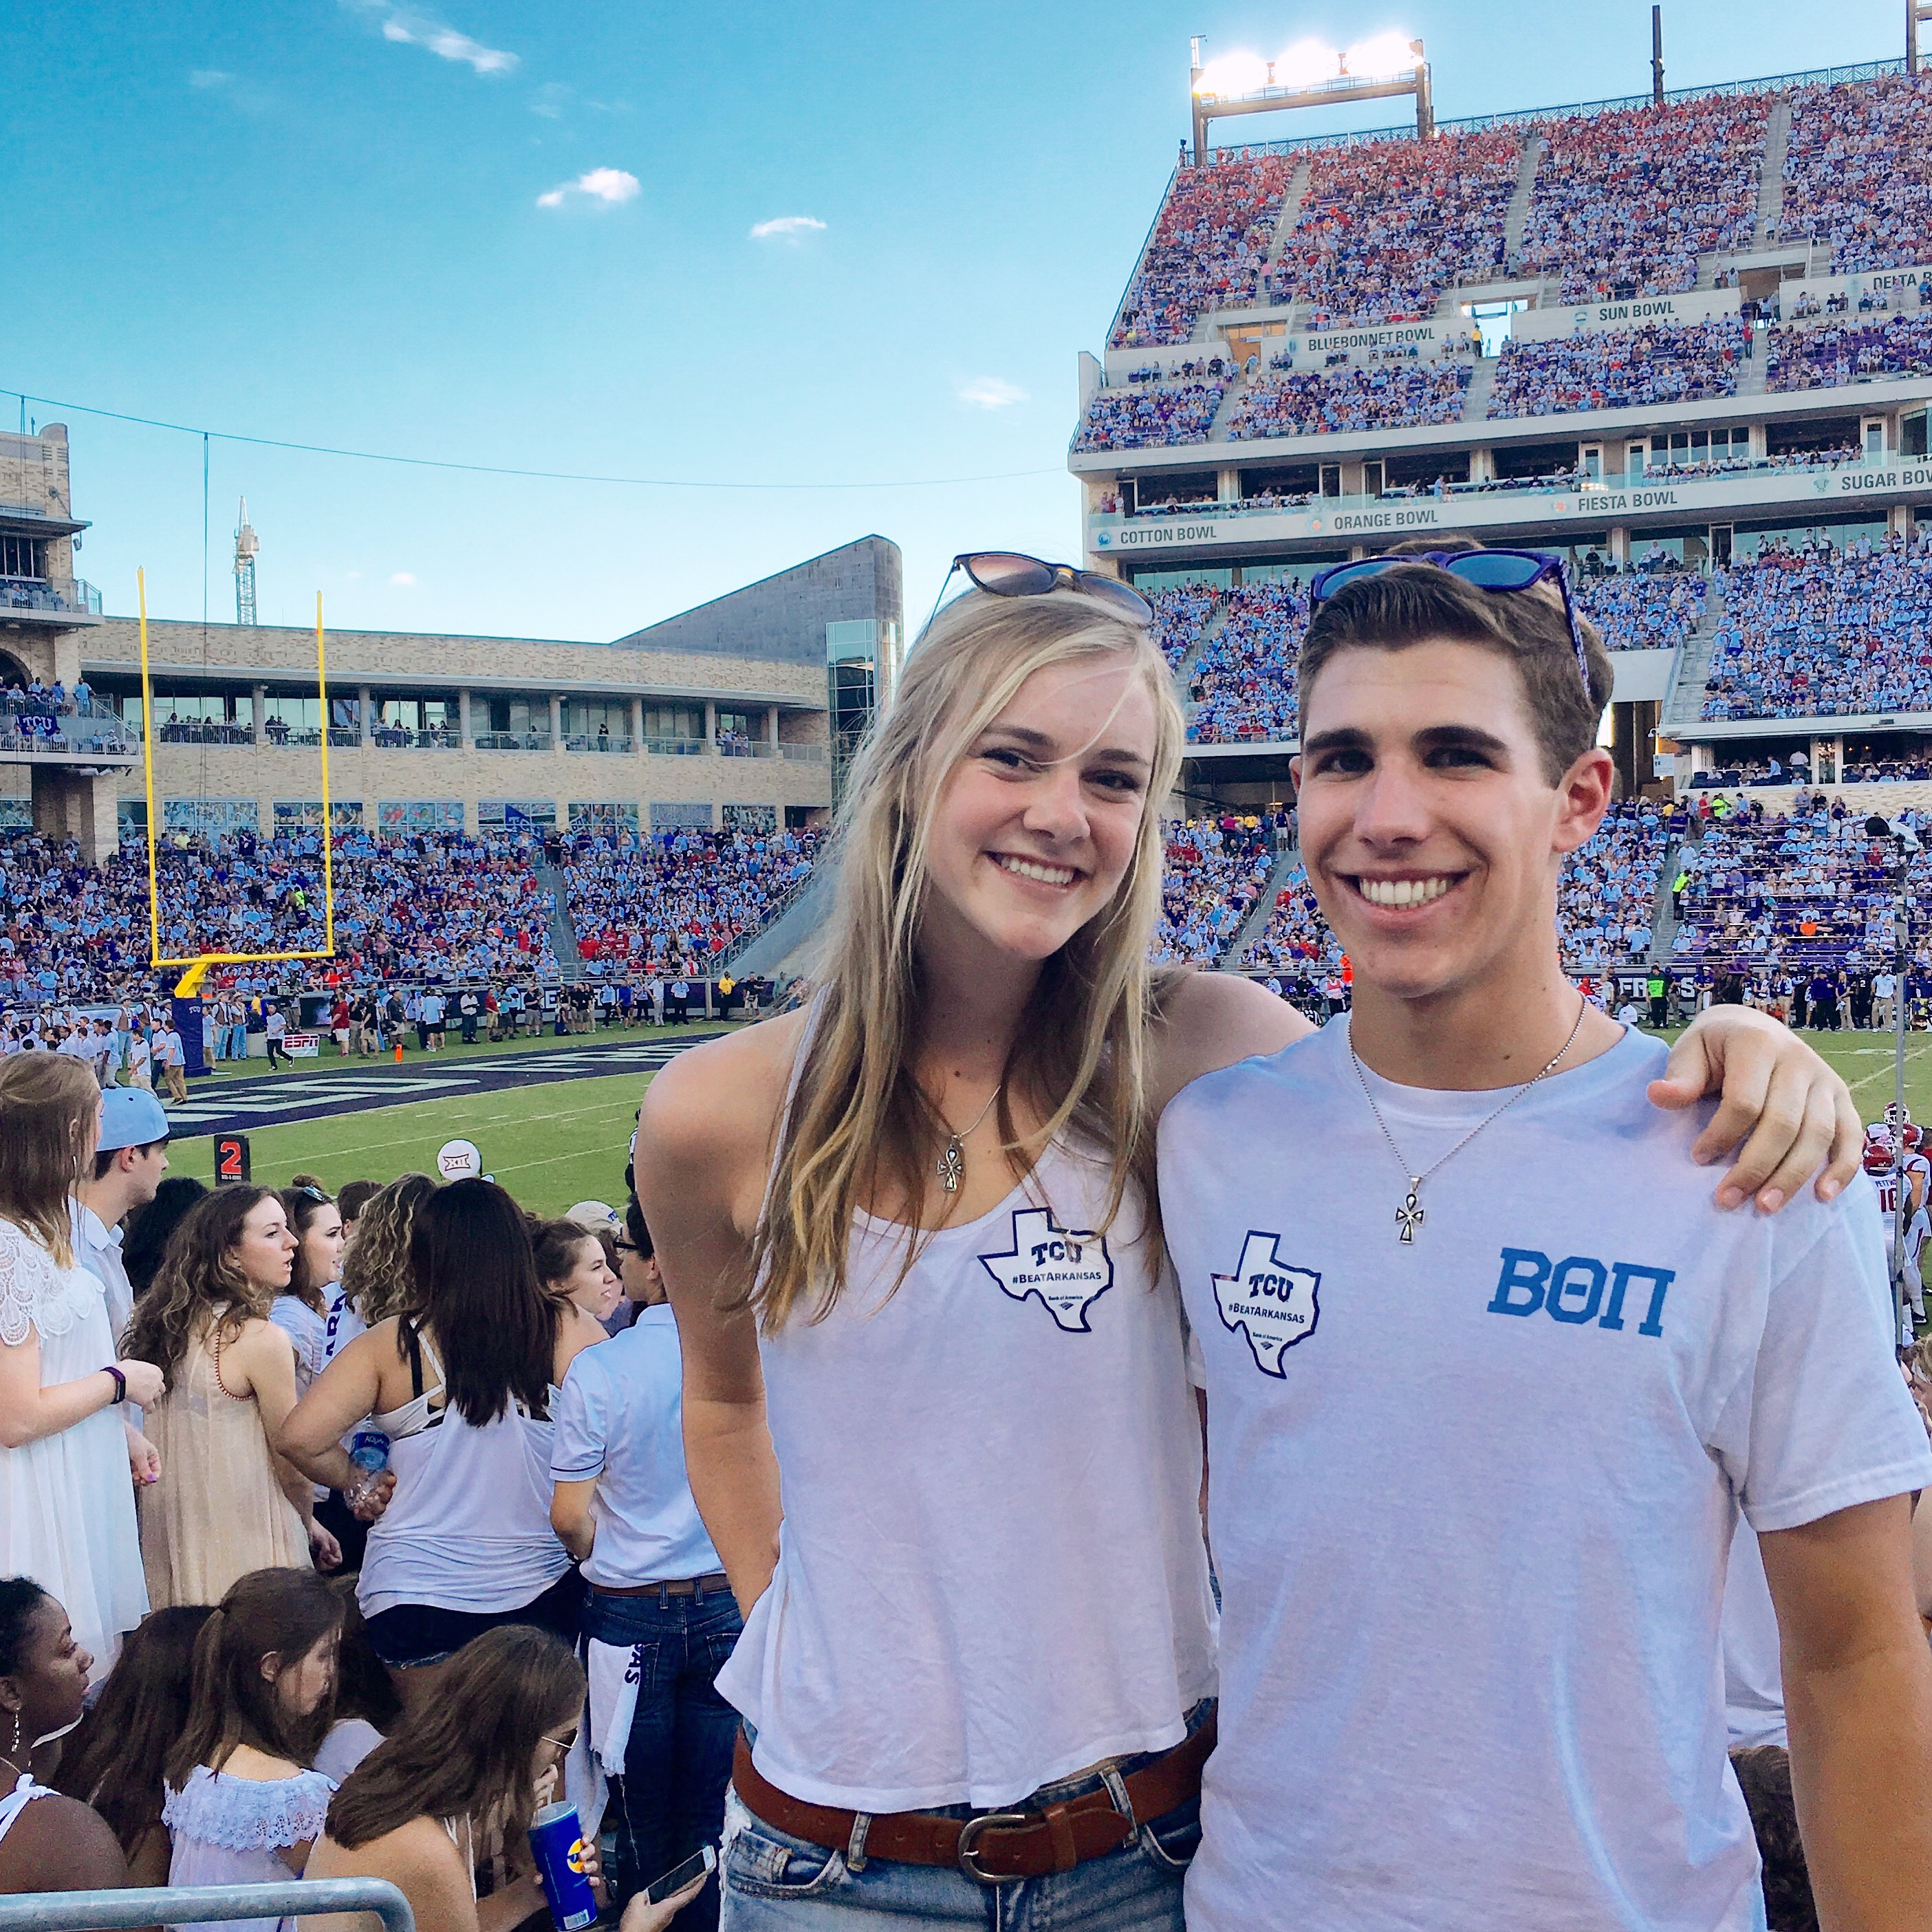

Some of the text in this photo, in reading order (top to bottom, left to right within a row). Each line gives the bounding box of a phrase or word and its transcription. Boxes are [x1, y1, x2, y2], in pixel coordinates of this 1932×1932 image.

[1874, 273, 1917, 290] DELTA
[1599, 301, 1675, 321] SUN BOWL
[1309, 327, 1435, 351] BLUEBONNET BOWL
[1841, 473, 1896, 490] SUGAR
[1578, 491, 1678, 512] FIESTA BOWL
[1334, 510, 1438, 530] ORANGE BOWL
[1120, 526, 1217, 544] COTTON BOWL
[23, 715, 52, 730] TCU
[284, 1035, 318, 1048] ESPN
[220, 1141, 242, 1175] 2
[1031, 1241, 1083, 1267] TCU
[1248, 1273, 1294, 1303] TCU
